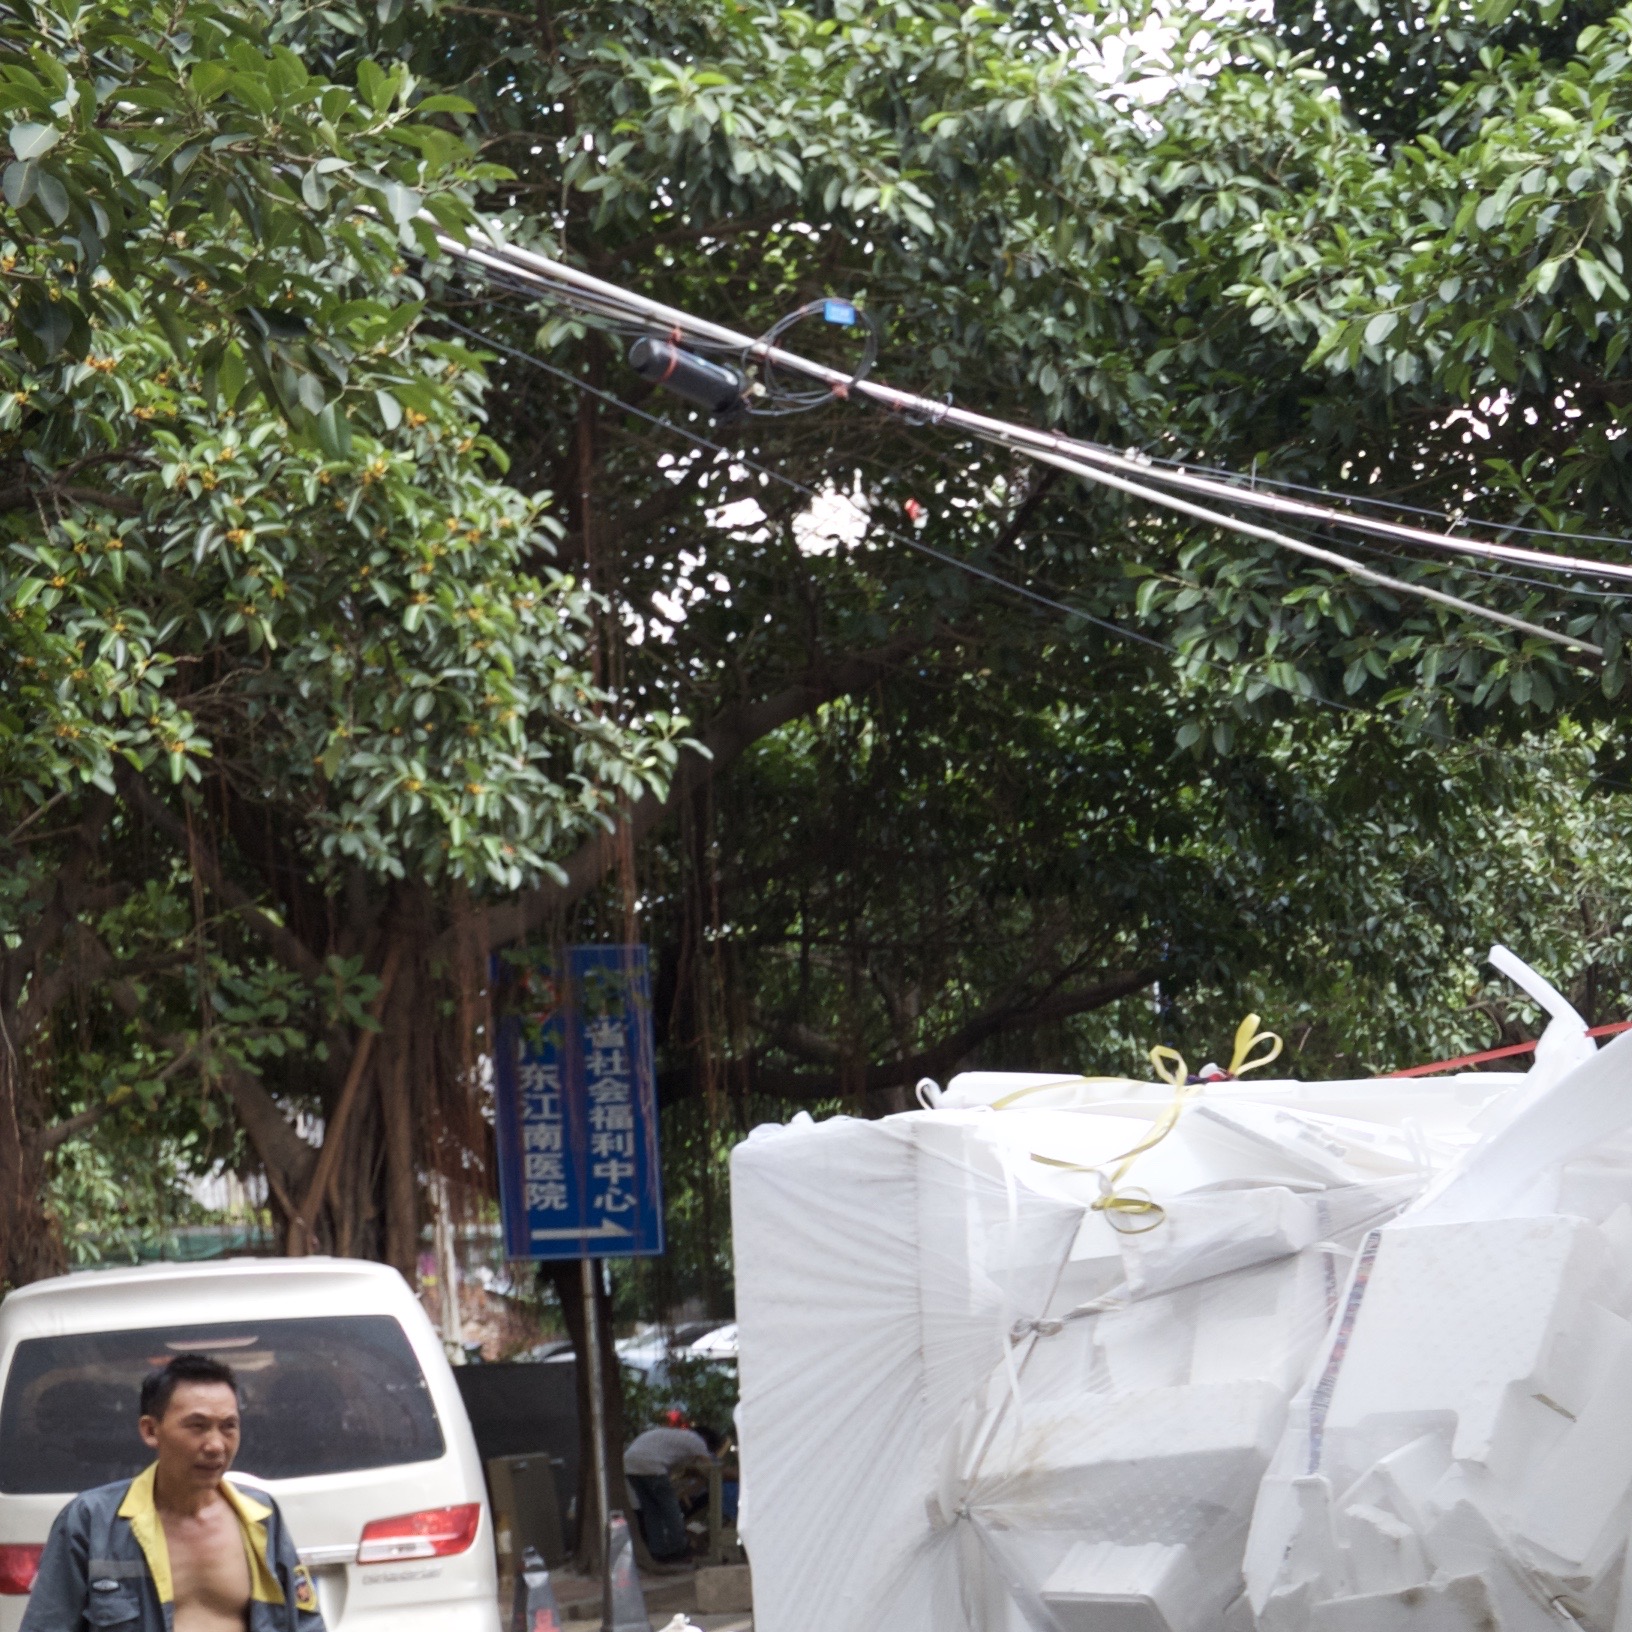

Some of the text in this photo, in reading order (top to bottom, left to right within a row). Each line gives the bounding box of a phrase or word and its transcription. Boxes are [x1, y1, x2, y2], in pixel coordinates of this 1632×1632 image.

[518, 1037, 569, 1212] 东江南医院
[584, 968, 638, 1214] 省社会福利中心
